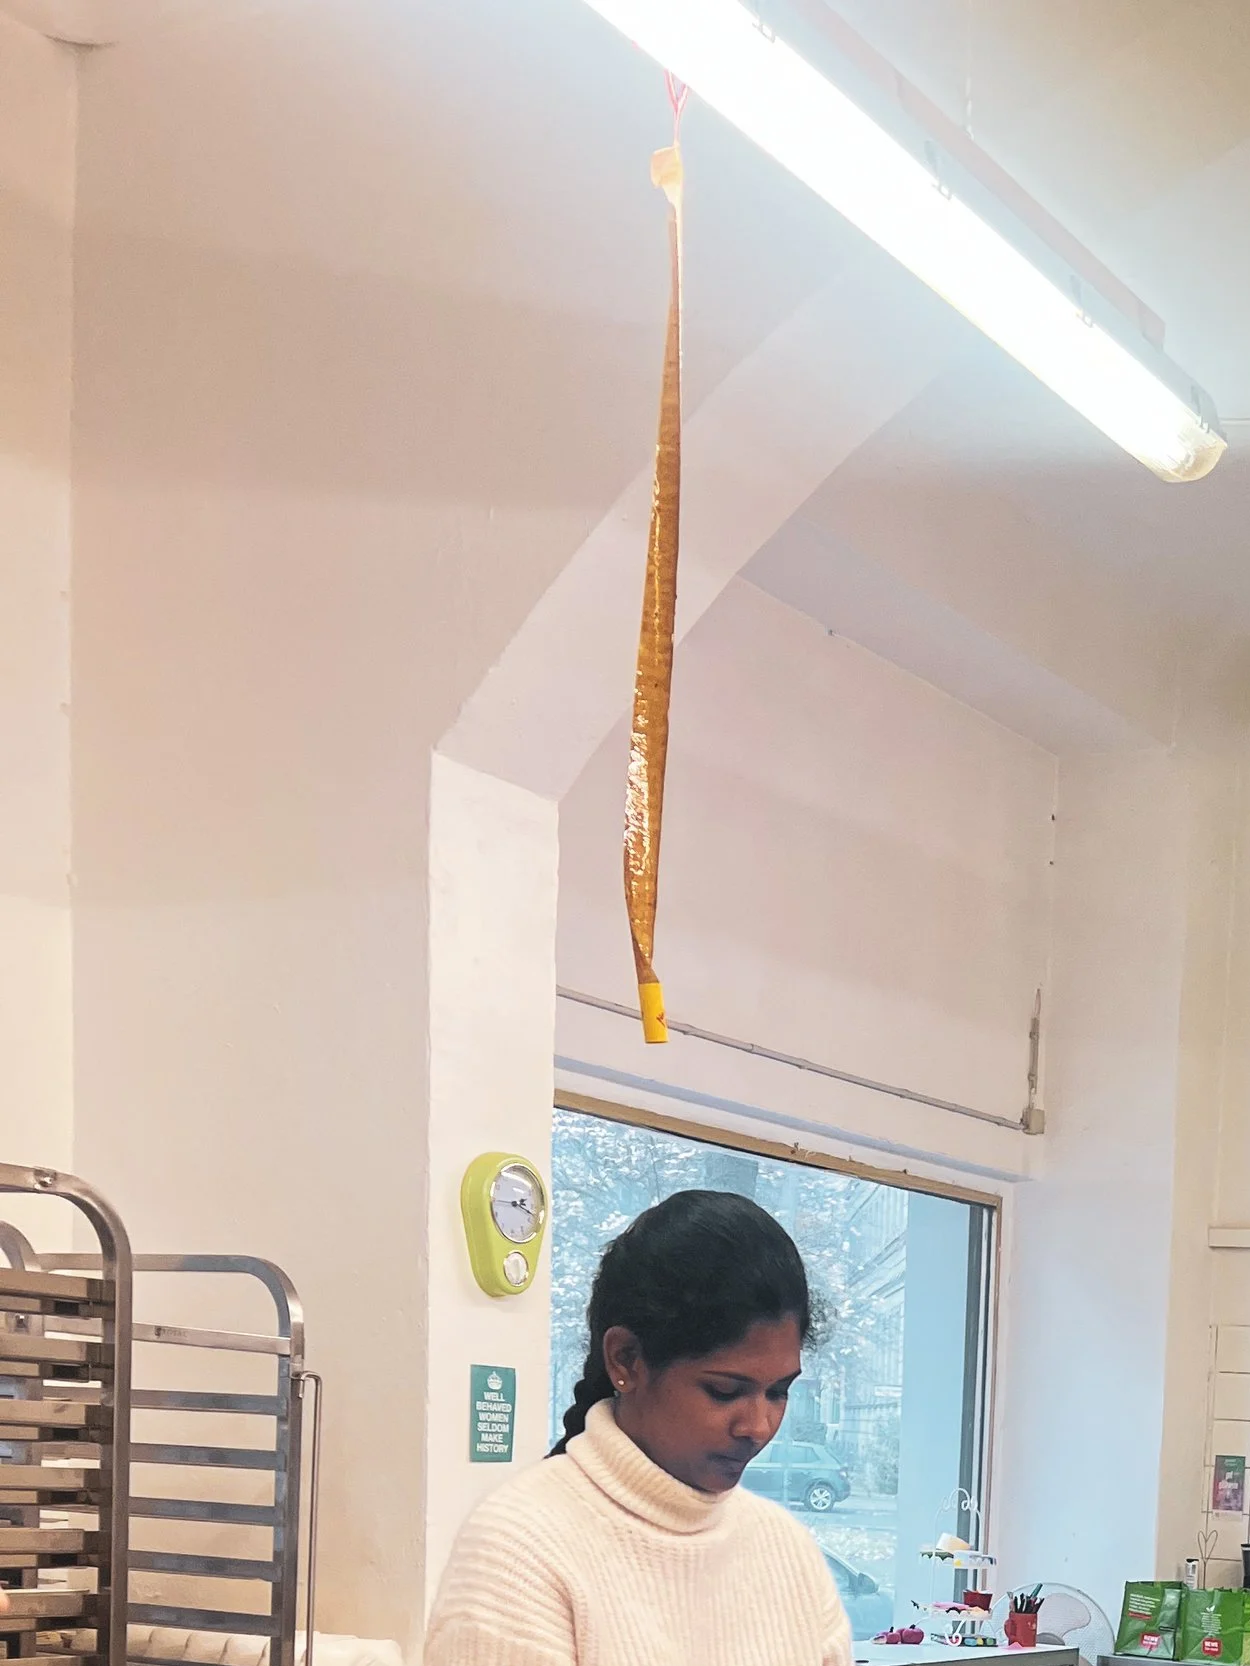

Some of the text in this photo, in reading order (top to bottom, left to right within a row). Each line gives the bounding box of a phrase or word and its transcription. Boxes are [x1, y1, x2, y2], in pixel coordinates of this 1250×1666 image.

[483, 1391, 506, 1402] WELL
[475, 1401, 512, 1413] BEHAVED
[478, 1412, 509, 1423] WOMEN
[477, 1422, 510, 1433] SELDOM
[480, 1432, 504, 1443] MAKE
[476, 1443, 509, 1453] HISTORY
